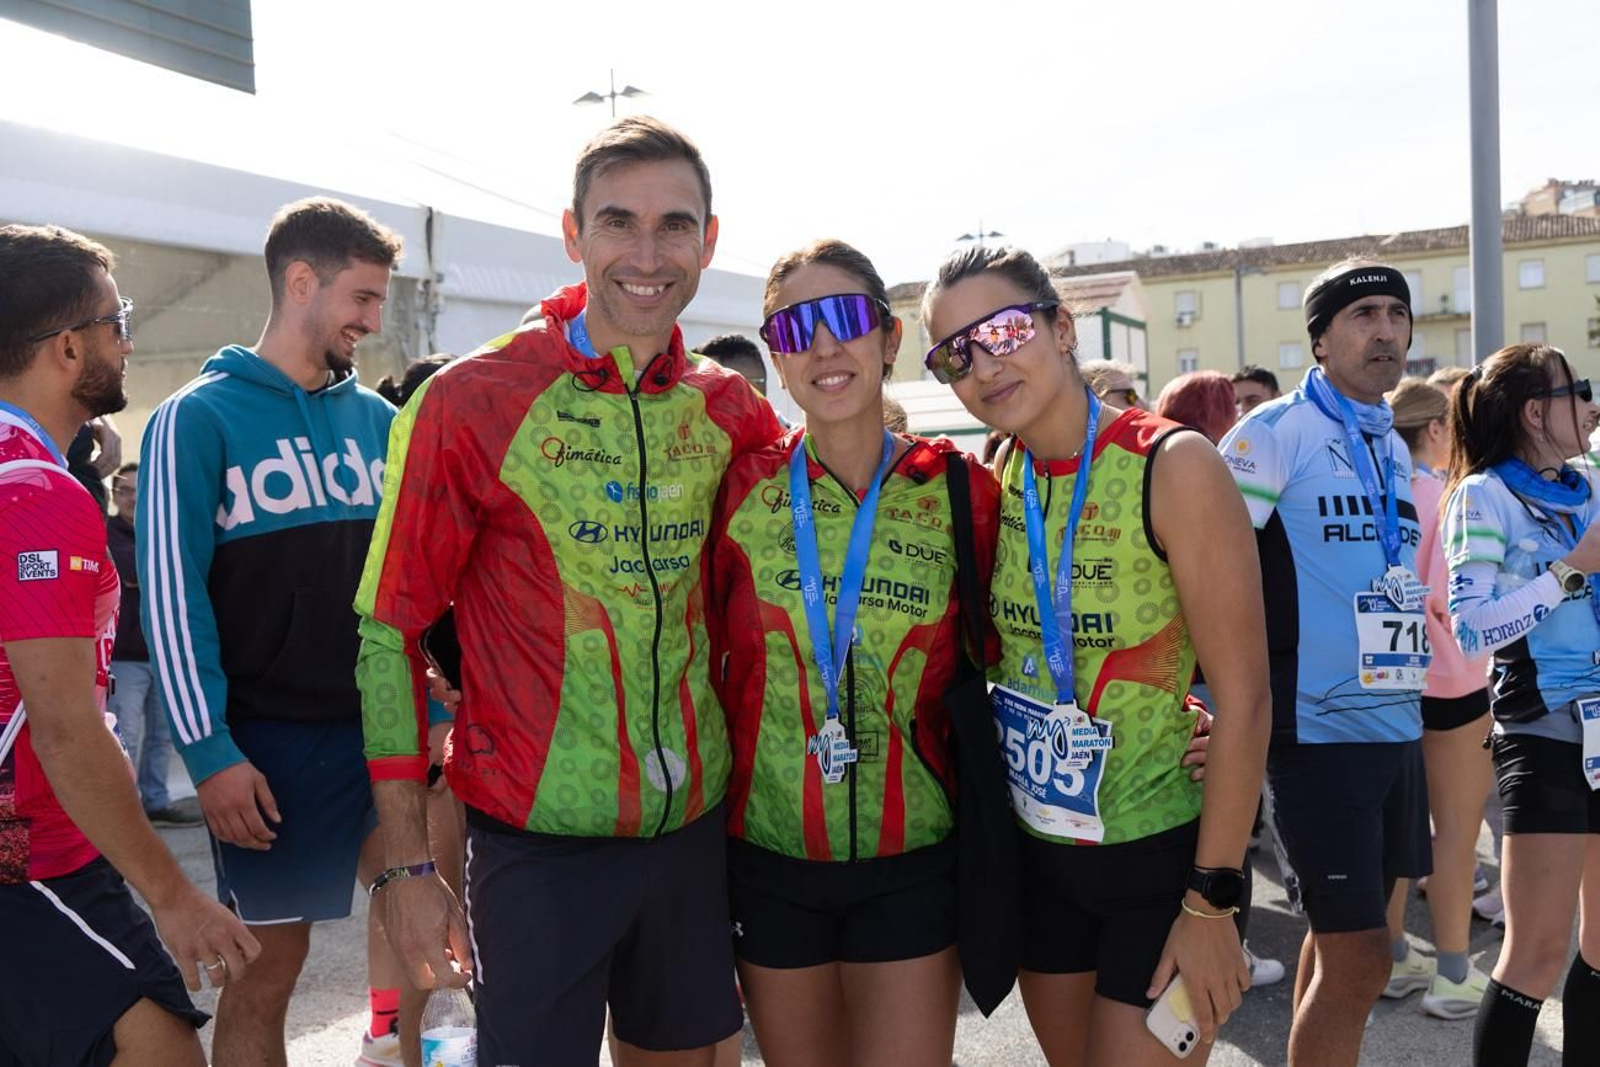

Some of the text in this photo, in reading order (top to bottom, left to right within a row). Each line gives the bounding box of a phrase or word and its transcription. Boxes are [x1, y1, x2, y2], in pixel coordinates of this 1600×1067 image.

[1349, 275, 1388, 287] KALENJI
[215, 437, 387, 530] adid
[761, 485, 842, 514] Ofitica
[614, 519, 704, 543] HYUNDAI
[1323, 523, 1422, 547] ALCDE
[19, 553, 43, 564] DSL
[609, 555, 690, 573] Jacarsa
[905, 543, 947, 565] DUE
[20, 562, 51, 572] SPORT
[20, 569, 56, 579] EVENTS
[1071, 564, 1112, 580] DUE
[822, 575, 930, 605] HUNDAI
[824, 592, 928, 618] Jarsa Motor
[1003, 600, 1113, 634] HYUAI
[1482, 613, 1534, 647] ZURICH
[1071, 635, 1114, 649] otor
[1071, 727, 1098, 736] MEDIA
[1071, 738, 1111, 748] MARATON
[1070, 749, 1090, 760] JAÉN
[1500, 988, 1541, 1011] MARA
